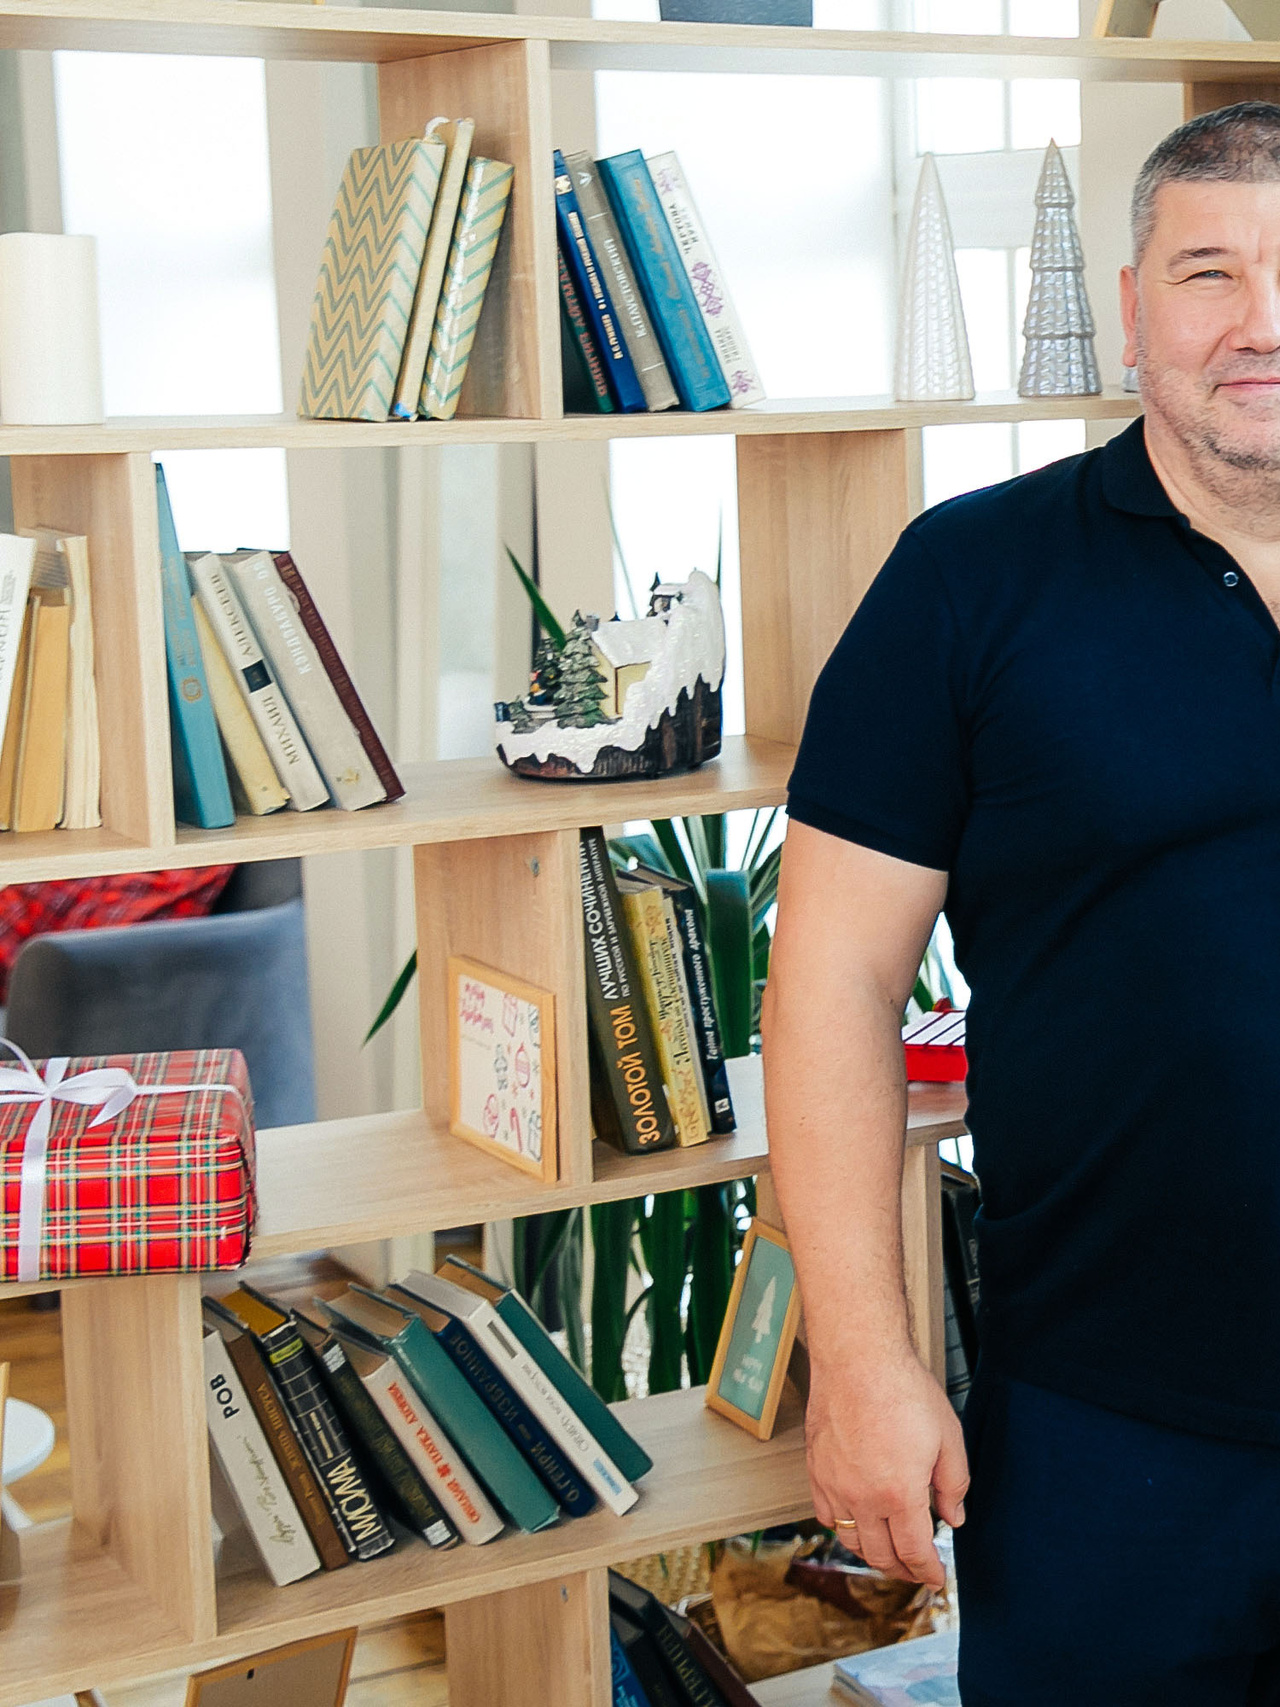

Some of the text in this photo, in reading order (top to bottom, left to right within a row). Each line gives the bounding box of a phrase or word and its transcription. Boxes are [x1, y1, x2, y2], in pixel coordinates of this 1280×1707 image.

[668, 202, 692, 255] ЧЕРТОВА
[207, 572, 301, 766] МИХАИЛ АЛЕКСЕЕВ
[586, 837, 606, 882] ЛИТЕРАТУРЕ
[596, 882, 618, 935] ЗАРУБЕЖНОЙ
[682, 907, 701, 952] дракона
[589, 934, 621, 1002] ЛУЧШИХ
[610, 944, 629, 983] РУССКОЙ
[620, 983, 631, 997] ПО
[608, 1003, 639, 1049] ТОМ
[701, 1029, 720, 1061] Тайна
[615, 1051, 662, 1147] ЗОЛОТОЙ
[208, 1372, 241, 1420] РОВ
[450, 1333, 520, 1422] ИЗБРАННОЕ
[415, 1425, 444, 1465] НАУКА
